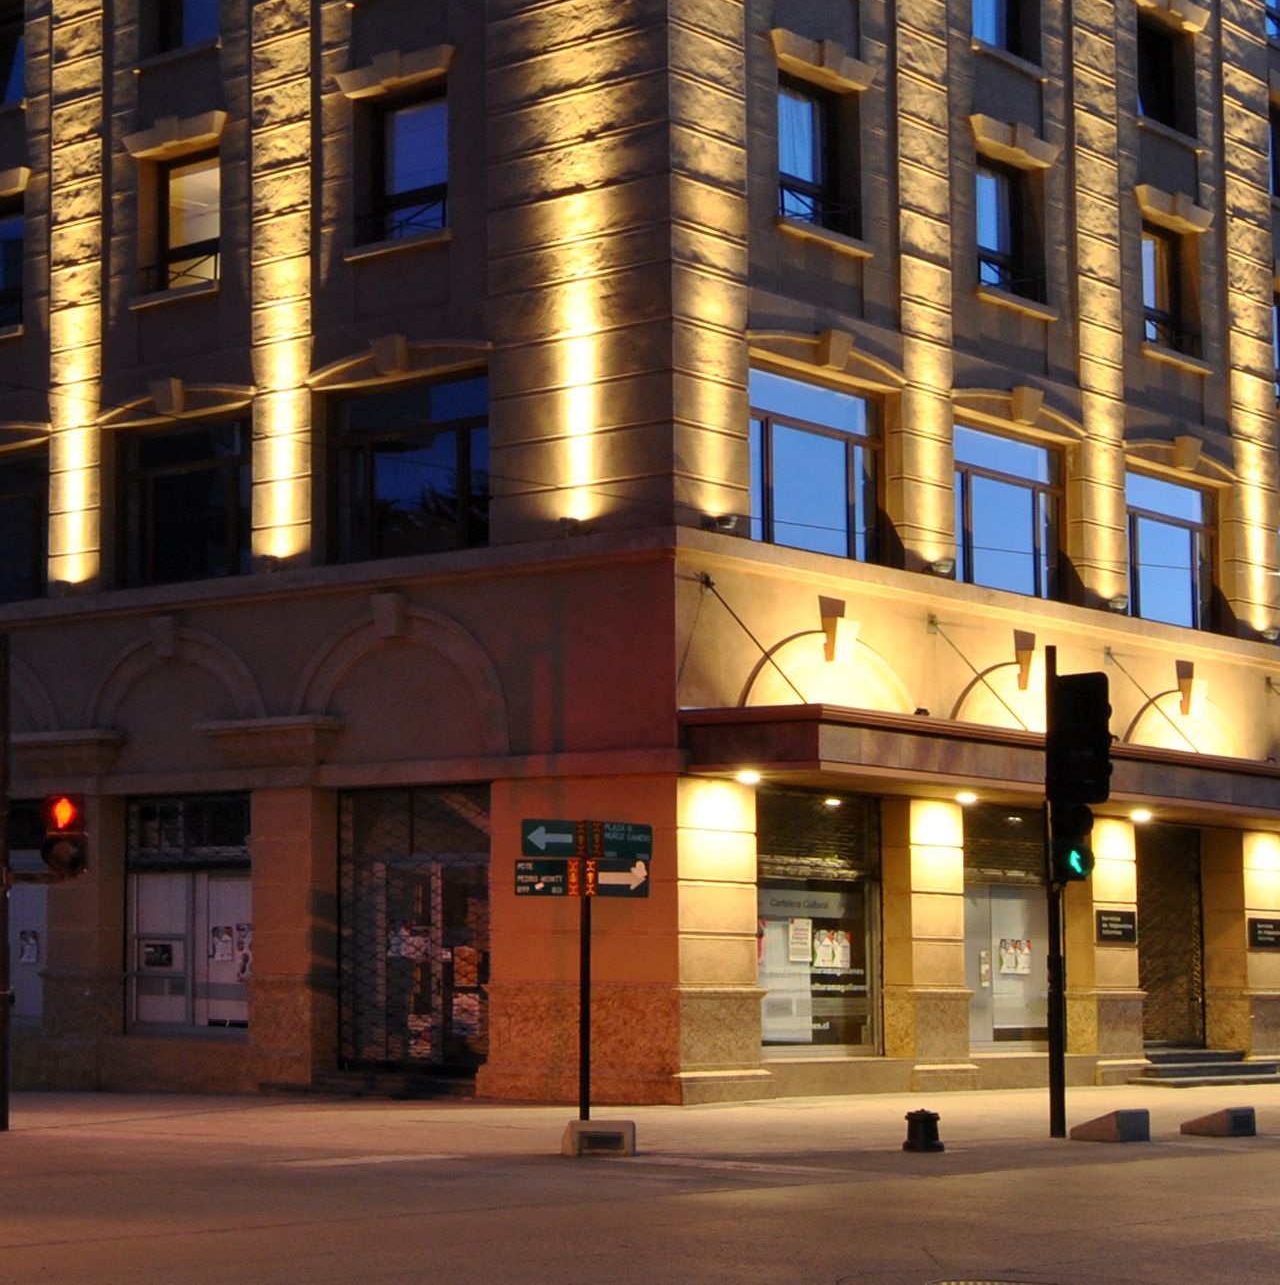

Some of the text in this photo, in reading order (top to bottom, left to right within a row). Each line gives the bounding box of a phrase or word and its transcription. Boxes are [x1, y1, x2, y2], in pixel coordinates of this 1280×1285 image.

[604, 823, 625, 832] PLAZA
[517, 875, 563, 883] PEDRO MONTT
[803, 899, 829, 909] Cultural
